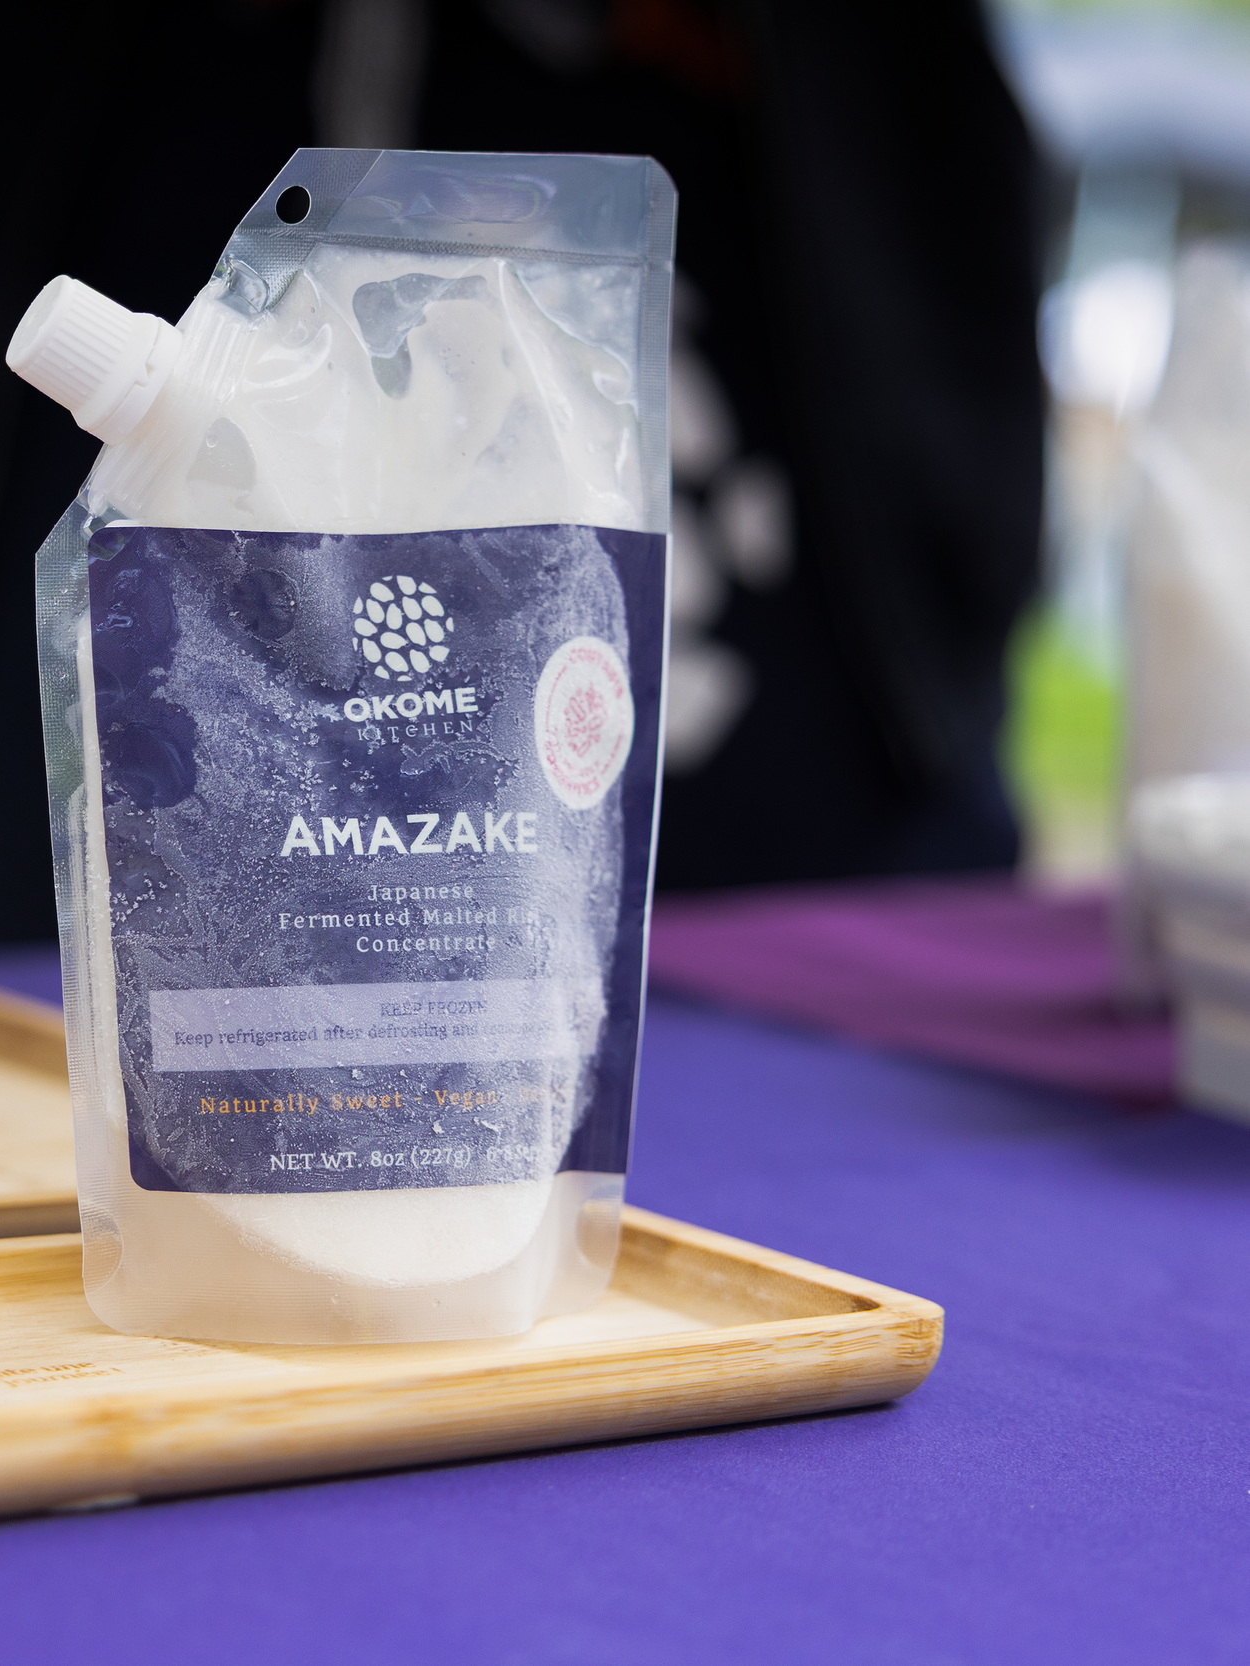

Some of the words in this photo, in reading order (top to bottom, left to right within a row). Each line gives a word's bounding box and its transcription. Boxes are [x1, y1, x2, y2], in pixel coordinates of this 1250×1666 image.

[343, 686, 479, 723] OKOME
[357, 720, 473, 742] KITCHEN
[280, 811, 540, 857] AMAZAKE
[367, 884, 473, 904] Japanese
[278, 908, 411, 929] Fermented
[422, 906, 497, 926] Malted
[356, 934, 497, 953] Concentrate
[380, 1000, 422, 1017] KEEP
[174, 1030, 214, 1048] Keep
[219, 1026, 318, 1047] refrigerated
[323, 1024, 364, 1041] after
[367, 1022, 448, 1041] defrosting
[200, 1093, 319, 1116] Naturally
[330, 1092, 403, 1112] Sweet
[434, 1088, 498, 1110] Vegan
[270, 1151, 315, 1171] NET
[320, 1150, 363, 1170] WT.
[370, 1150, 405, 1168] 8oz
[410, 1144, 471, 1169] (227g)
